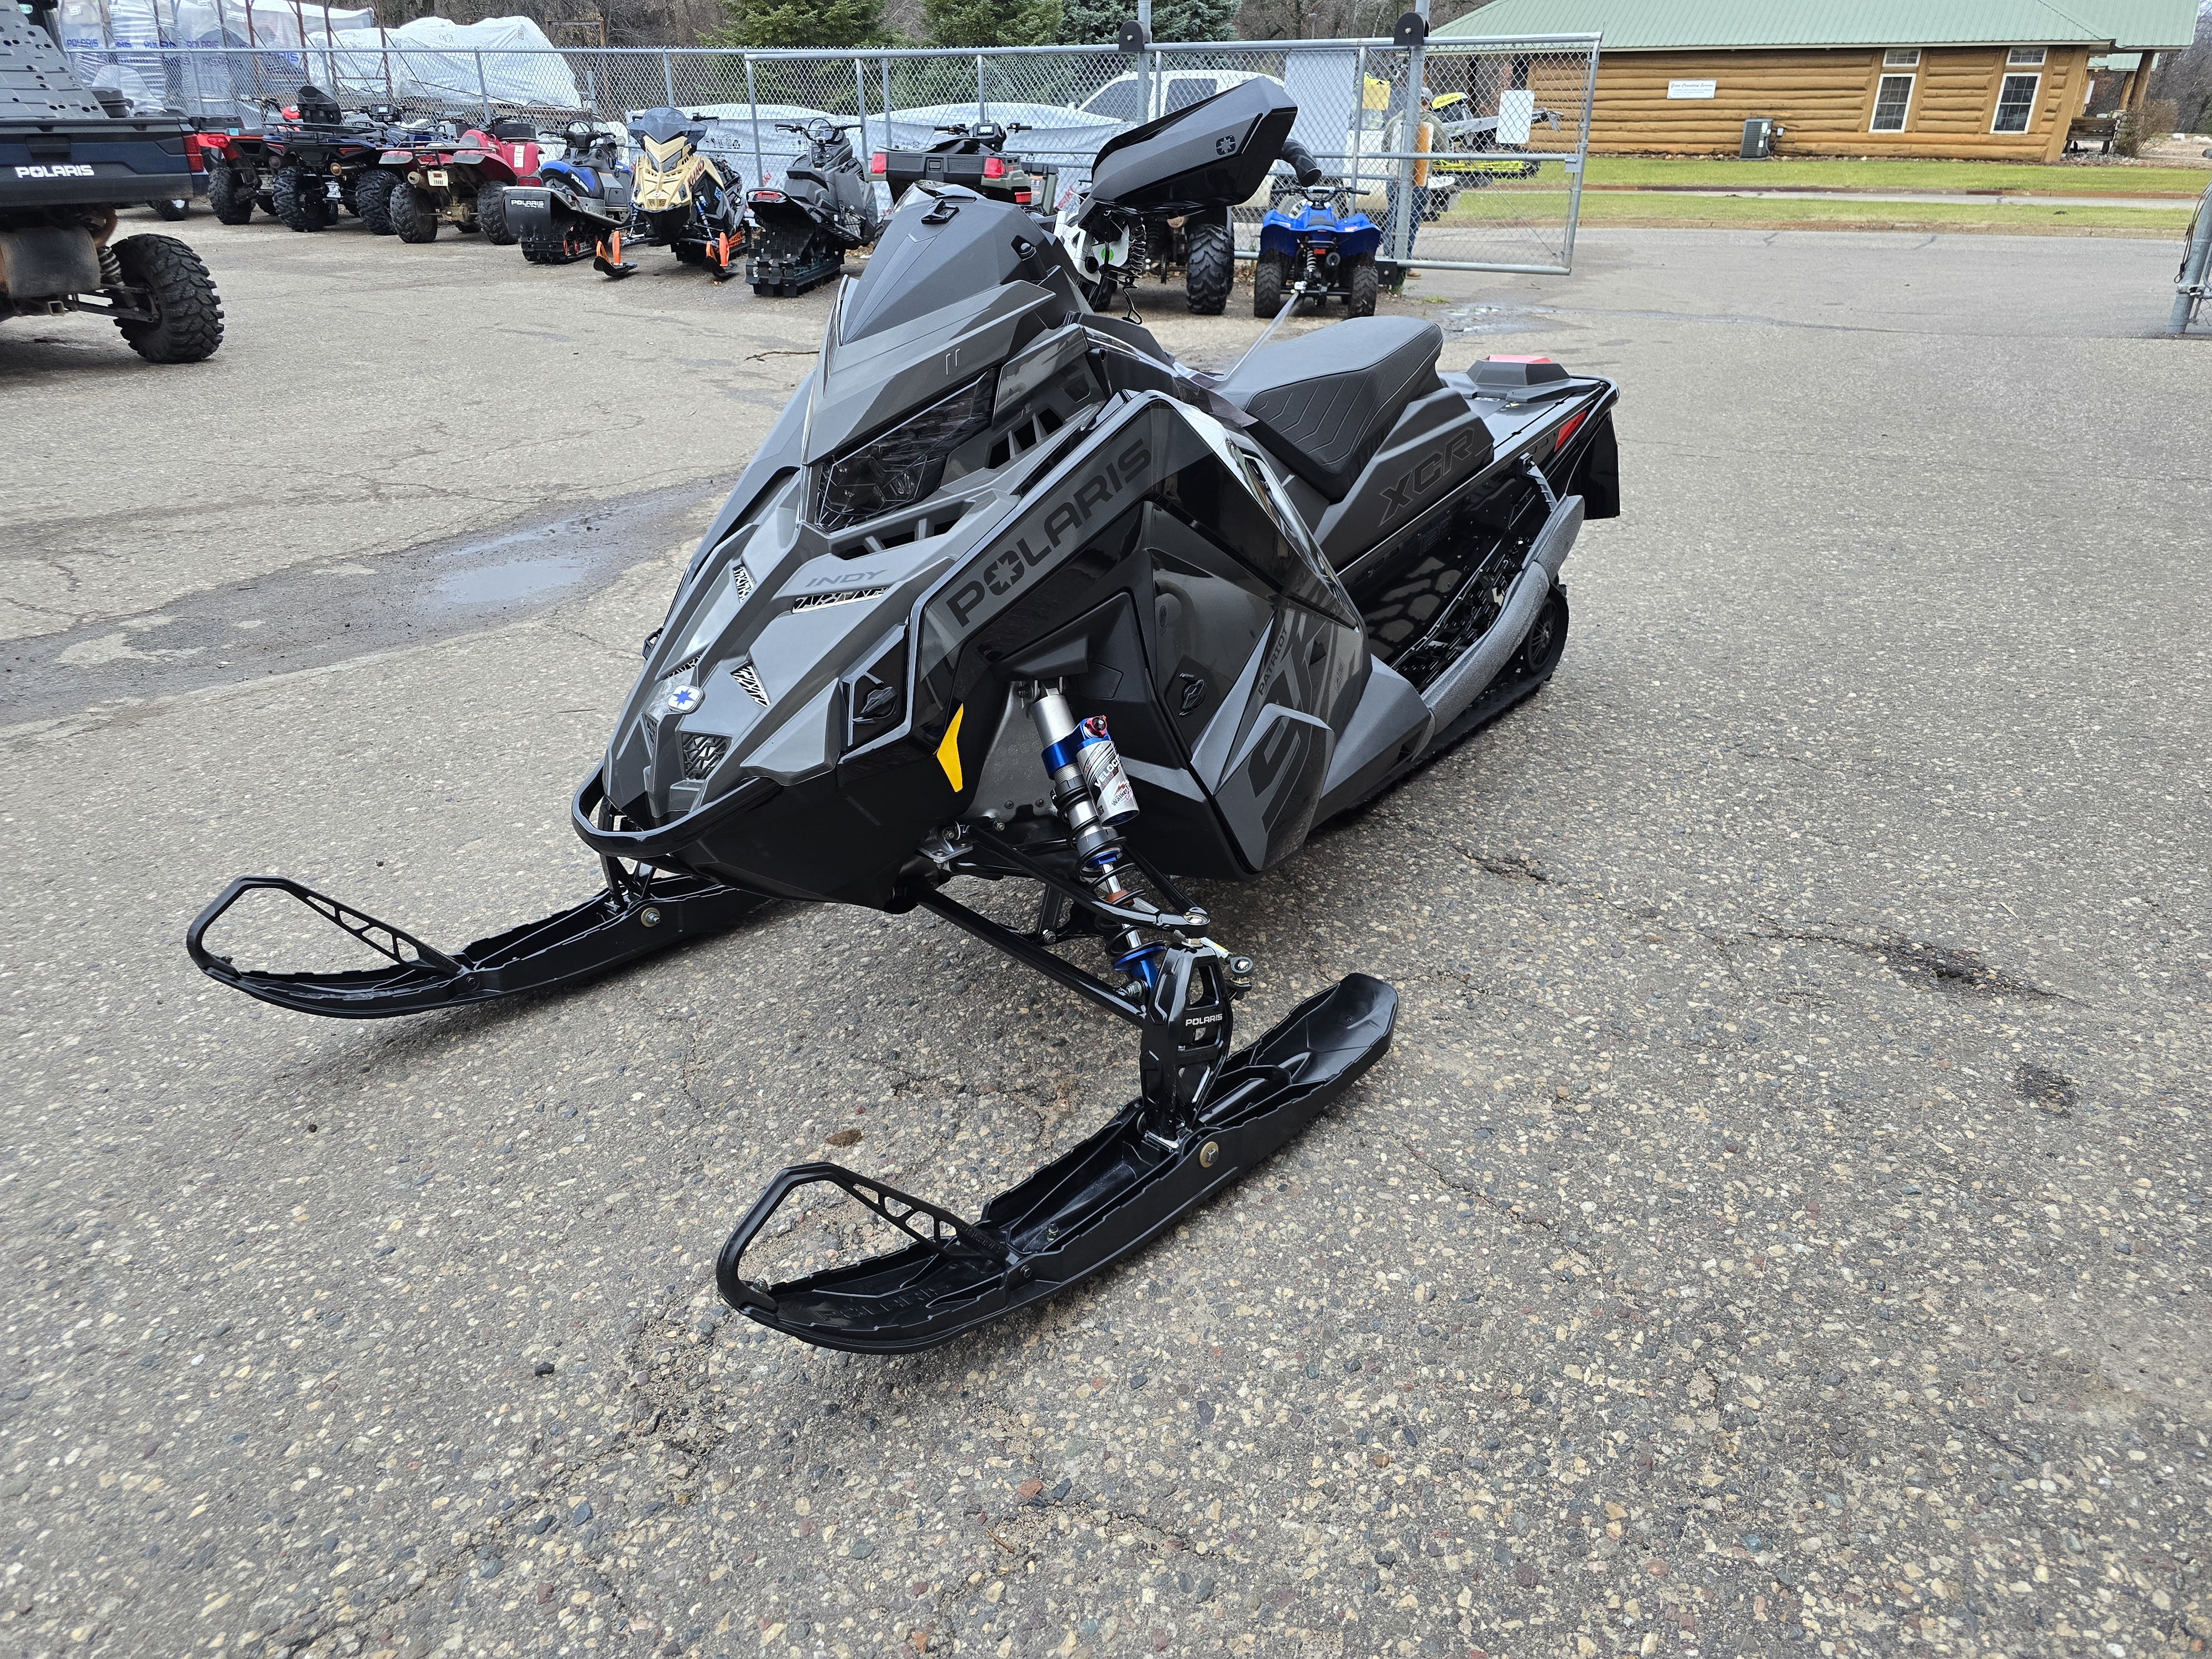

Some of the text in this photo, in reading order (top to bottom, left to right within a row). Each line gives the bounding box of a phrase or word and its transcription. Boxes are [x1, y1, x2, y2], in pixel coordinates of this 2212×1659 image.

[66, 38, 99, 48] POLARIS
[14, 165, 95, 178] POLARIS
[1378, 426, 1475, 528] XCR
[946, 438, 1151, 628] POLARIS
[805, 570, 888, 588] INDY
[1258, 624, 1288, 696] PATRIOT
[1185, 1013, 1223, 1026] POLARIS
